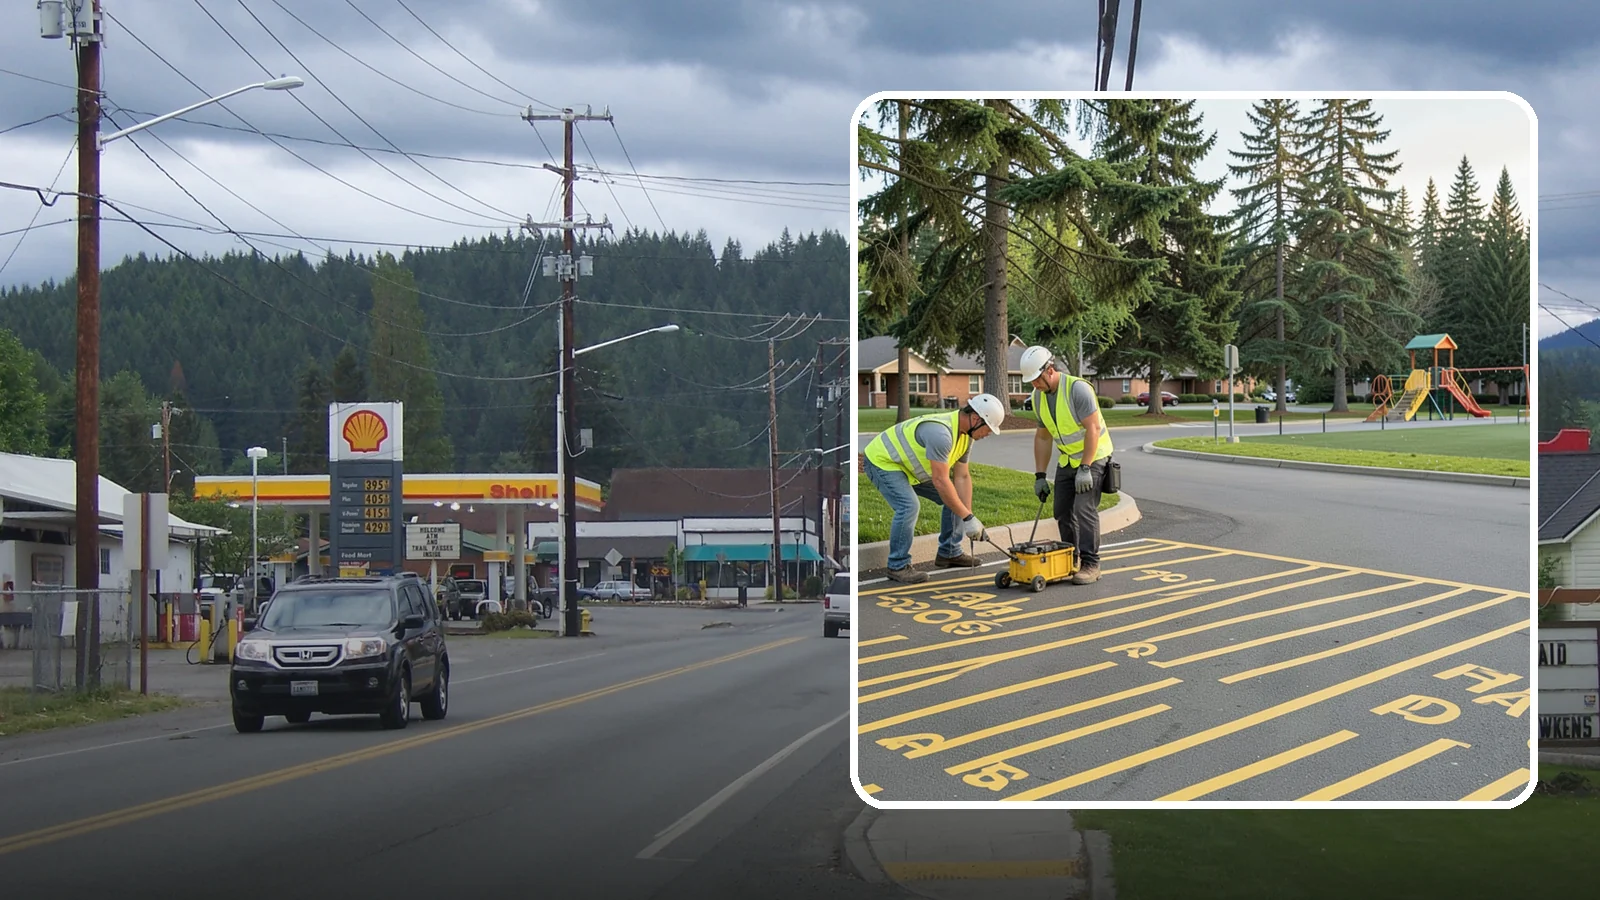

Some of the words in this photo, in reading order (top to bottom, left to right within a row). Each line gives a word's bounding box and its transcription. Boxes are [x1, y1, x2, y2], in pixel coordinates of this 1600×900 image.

[366, 480, 383, 490] 395
[490, 484, 547, 499] Shell
[366, 494, 383, 504] 405
[366, 508, 383, 518] 415
[366, 523, 383, 532] 429
